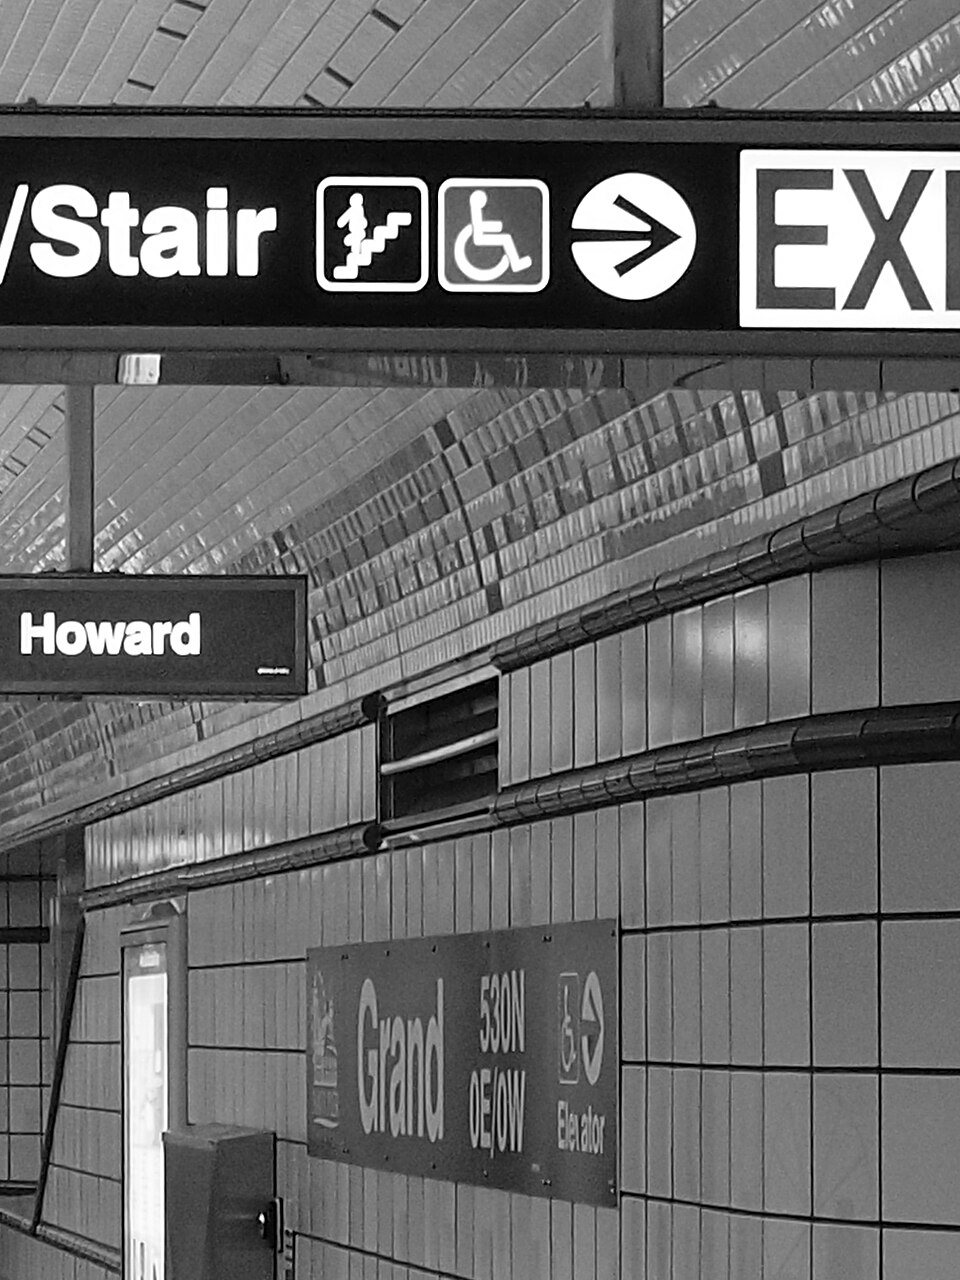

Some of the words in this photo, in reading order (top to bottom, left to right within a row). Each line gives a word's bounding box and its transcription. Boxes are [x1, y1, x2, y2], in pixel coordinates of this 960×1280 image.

[18, 612, 202, 657] Howard
[479, 967, 526, 1054] 530N
[357, 976, 444, 1143] Grand
